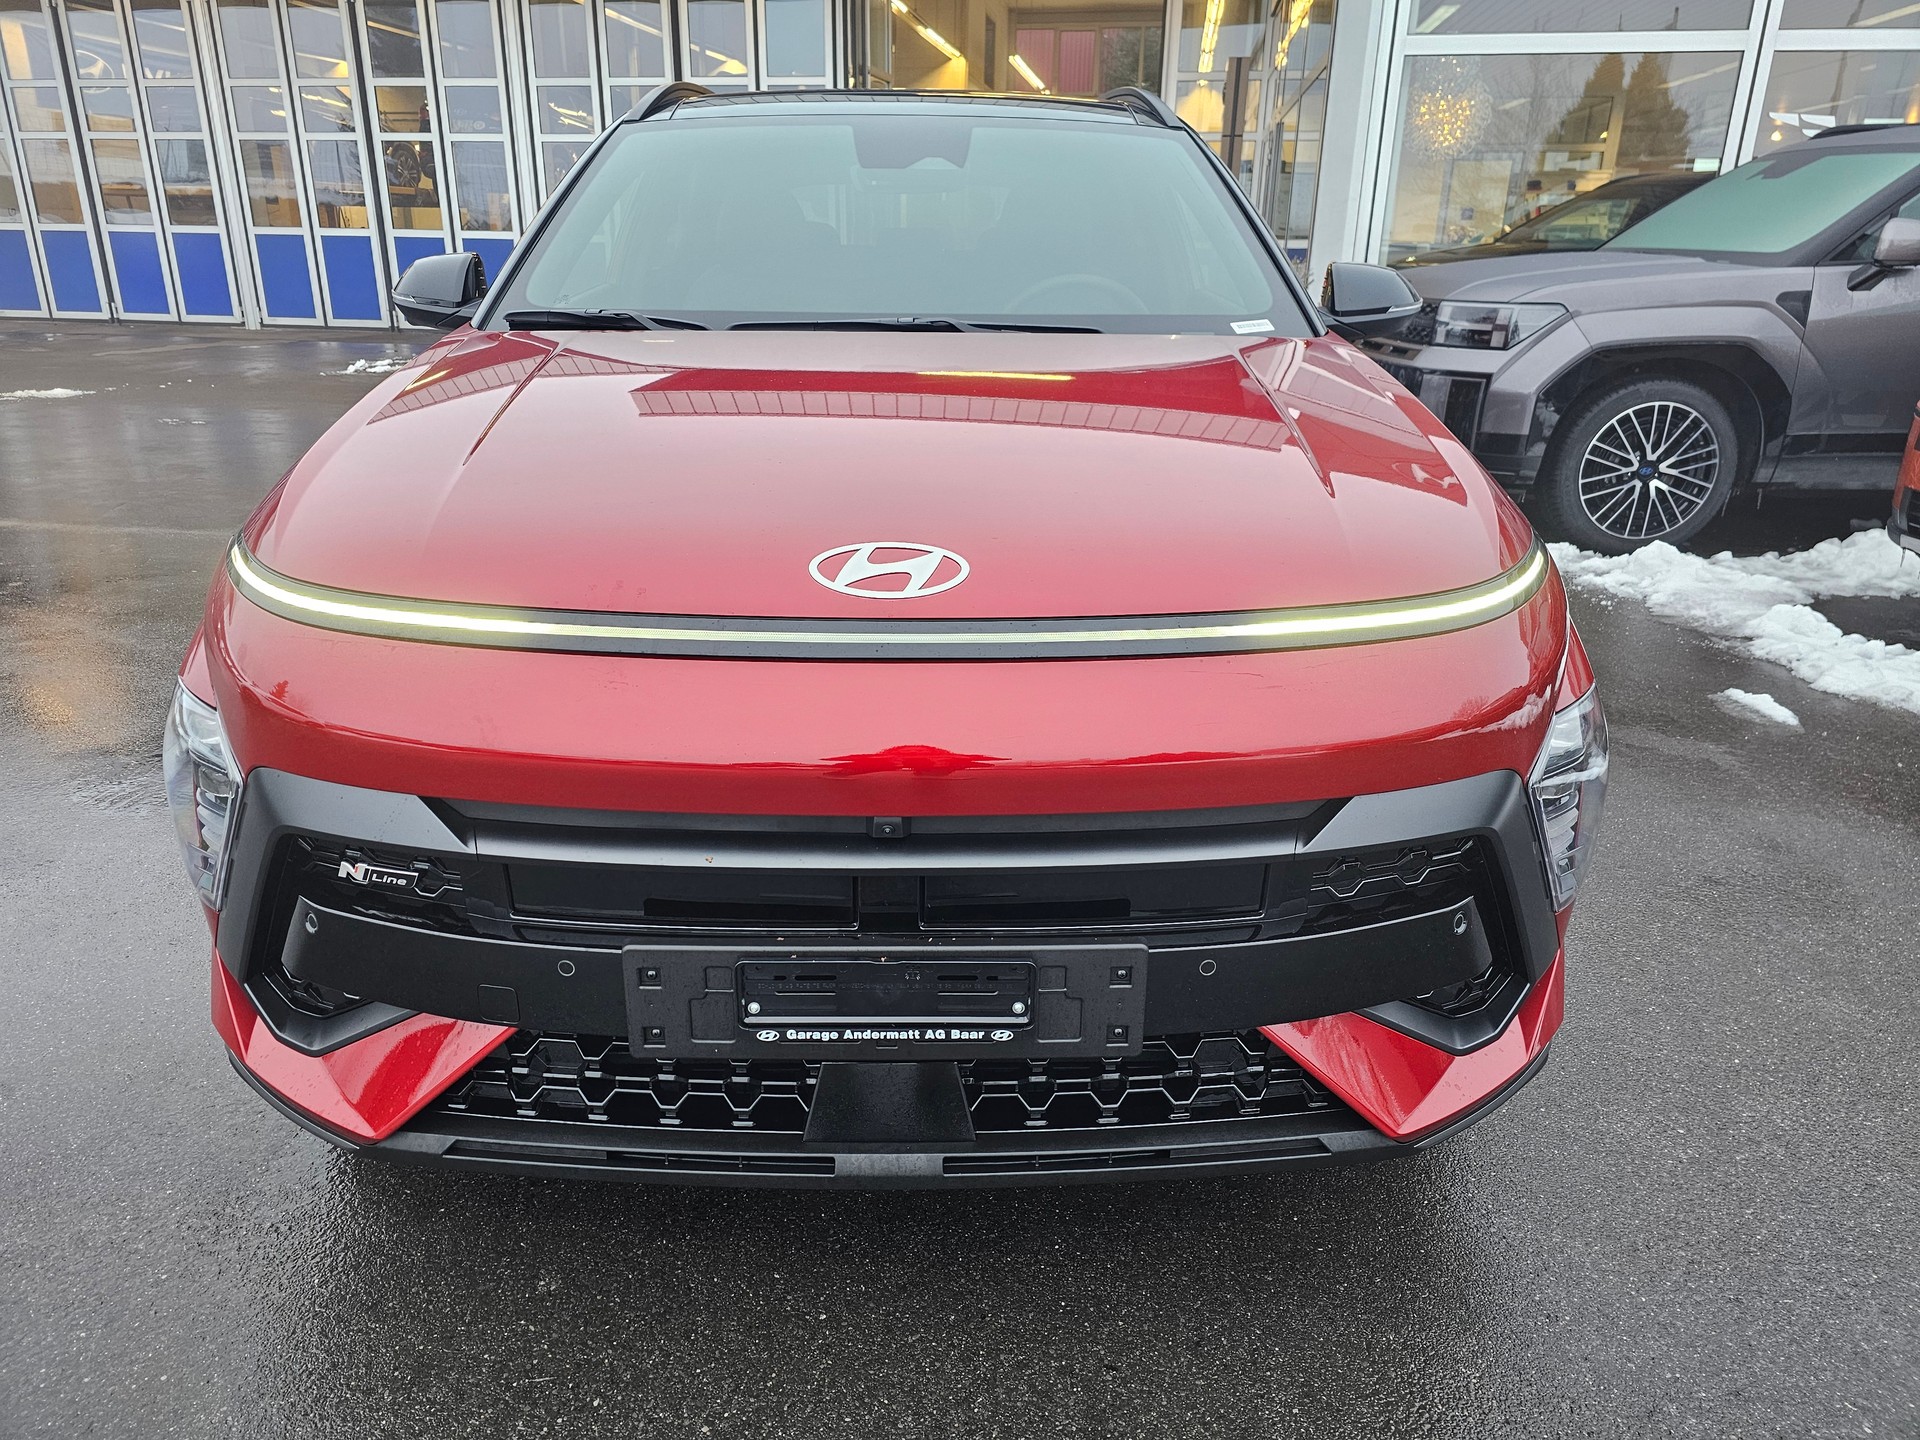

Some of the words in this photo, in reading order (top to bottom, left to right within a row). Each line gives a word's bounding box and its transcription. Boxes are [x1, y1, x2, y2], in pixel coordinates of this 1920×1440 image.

[338, 861, 368, 881] N
[371, 873, 407, 886] Line
[786, 1029, 839, 1041] Garage
[843, 1029, 920, 1040] Andermatt
[924, 1029, 946, 1040] AG
[950, 1029, 985, 1040] Baar
